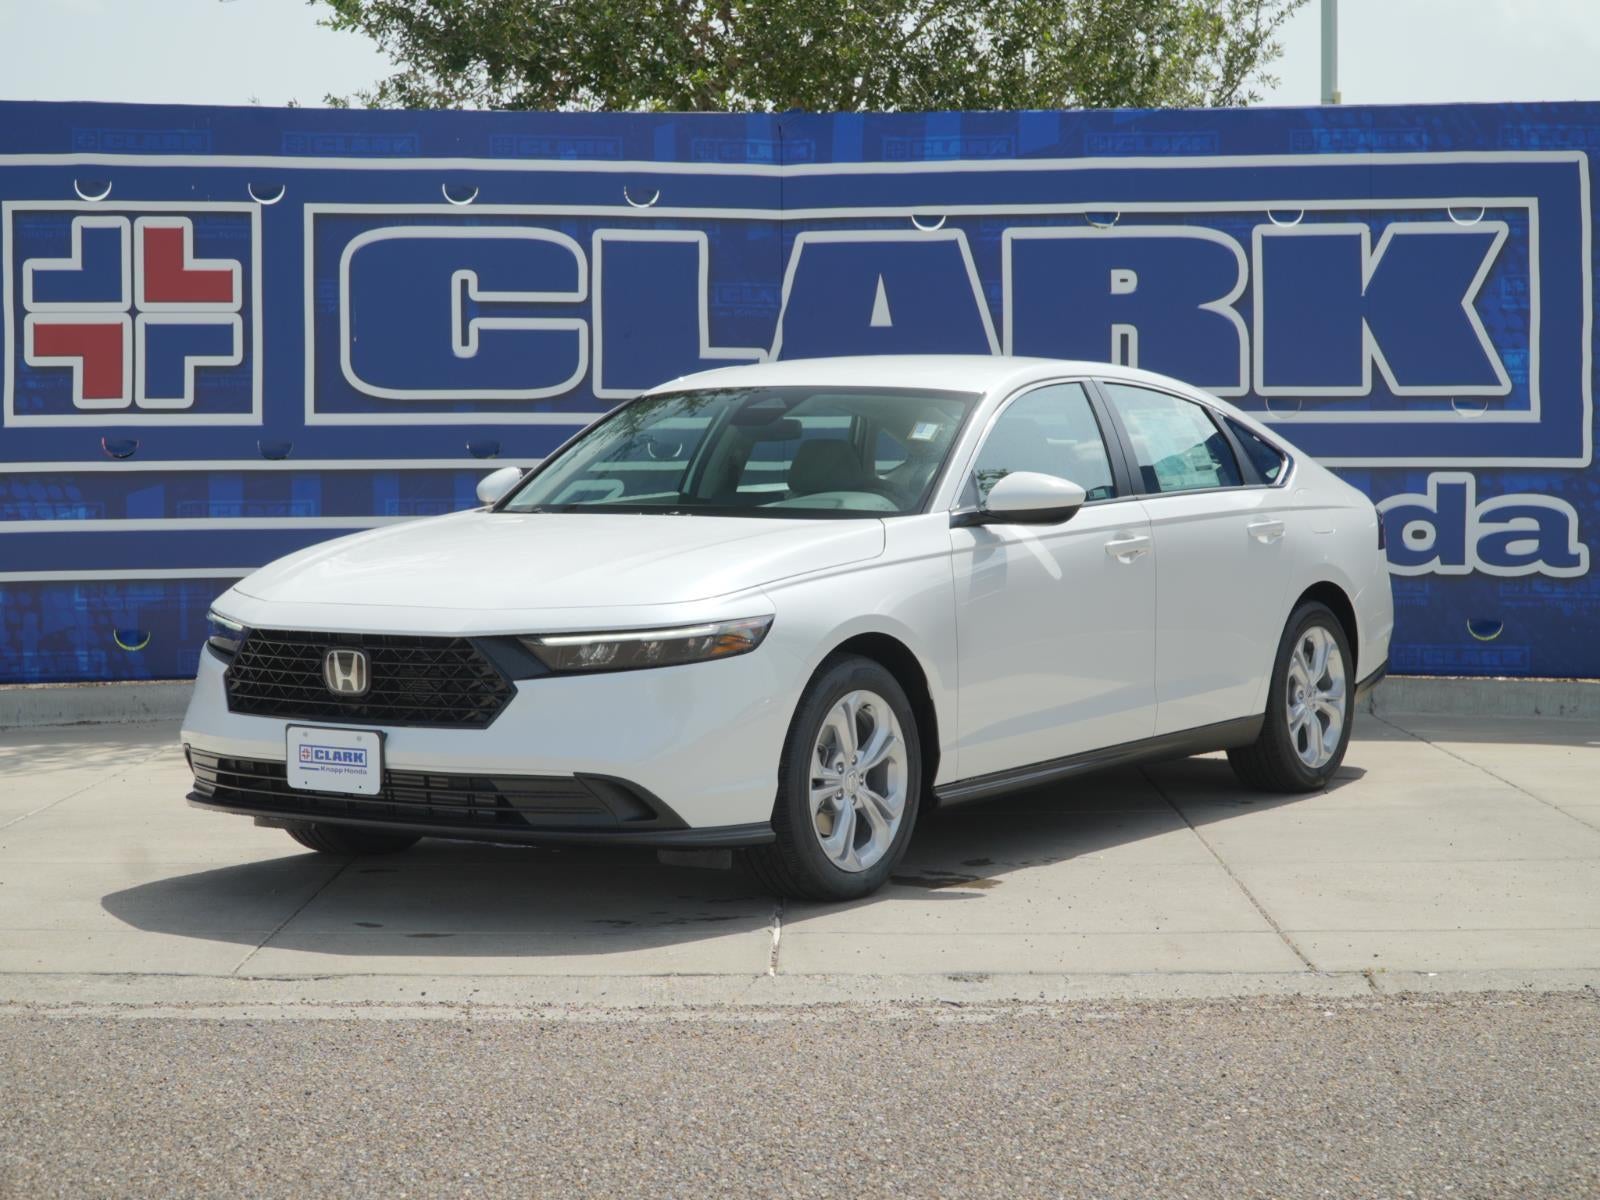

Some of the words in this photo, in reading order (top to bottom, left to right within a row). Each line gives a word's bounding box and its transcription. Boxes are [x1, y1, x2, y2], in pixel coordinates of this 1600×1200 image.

[340, 219, 1513, 400] CLARK
[314, 749, 364, 763] CLARK
[320, 765, 344, 775] Knapp
[344, 767, 368, 775] Honda
